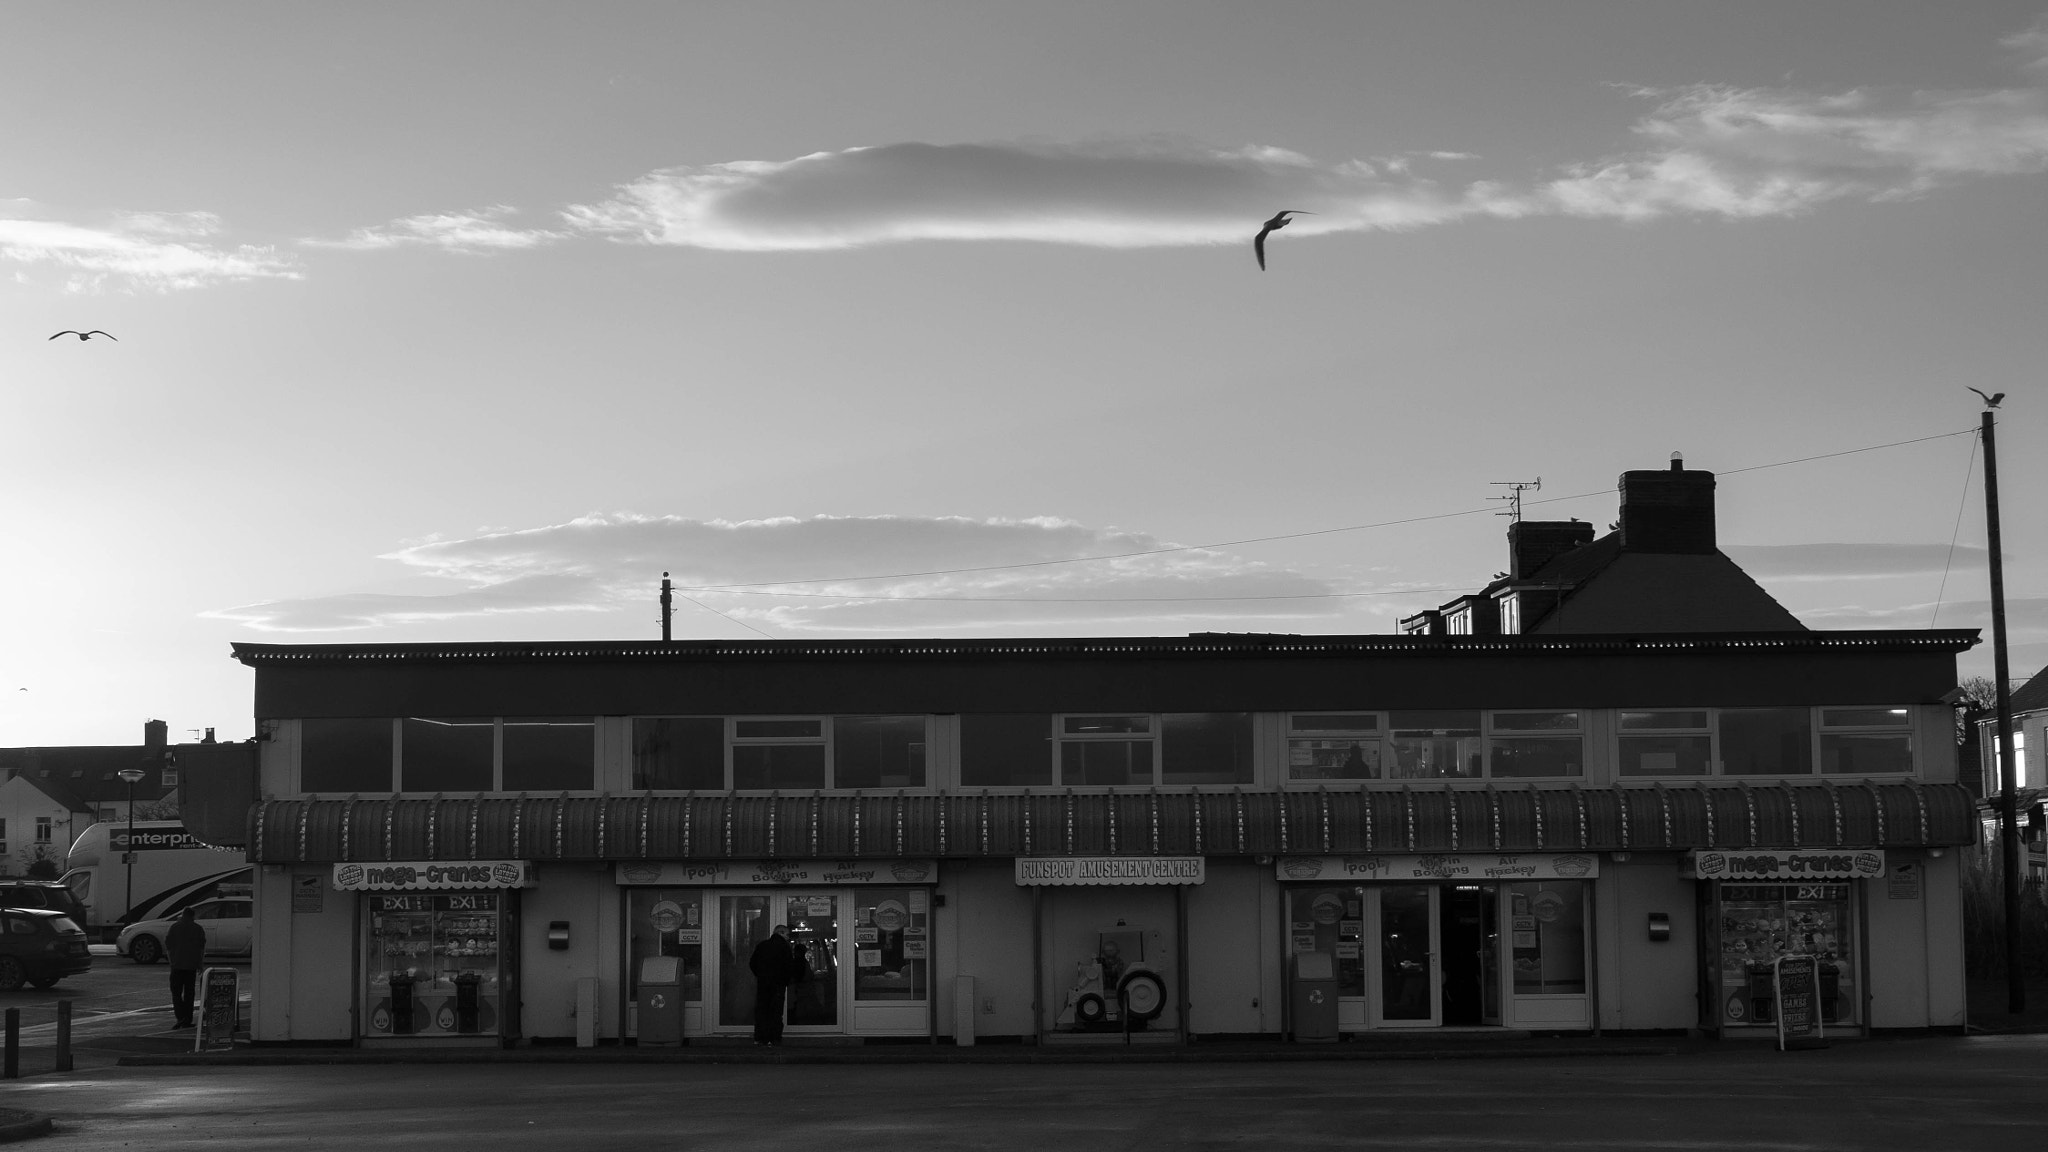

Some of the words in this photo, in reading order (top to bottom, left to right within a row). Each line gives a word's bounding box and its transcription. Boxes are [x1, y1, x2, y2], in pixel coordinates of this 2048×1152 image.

[116, 832, 194, 847] enterpri
[837, 862, 857, 870] Air
[1499, 857, 1518, 866] Air
[1022, 861, 1074, 878] FUNSPOT
[1079, 860, 1151, 878] AMUSEMENT
[1152, 860, 1198, 878] CENTRE
[1413, 866, 1469, 877] Bowling
[1485, 865, 1536, 877] Hockey
[752, 871, 808, 881] Bowling
[823, 870, 876, 881] Hockey
